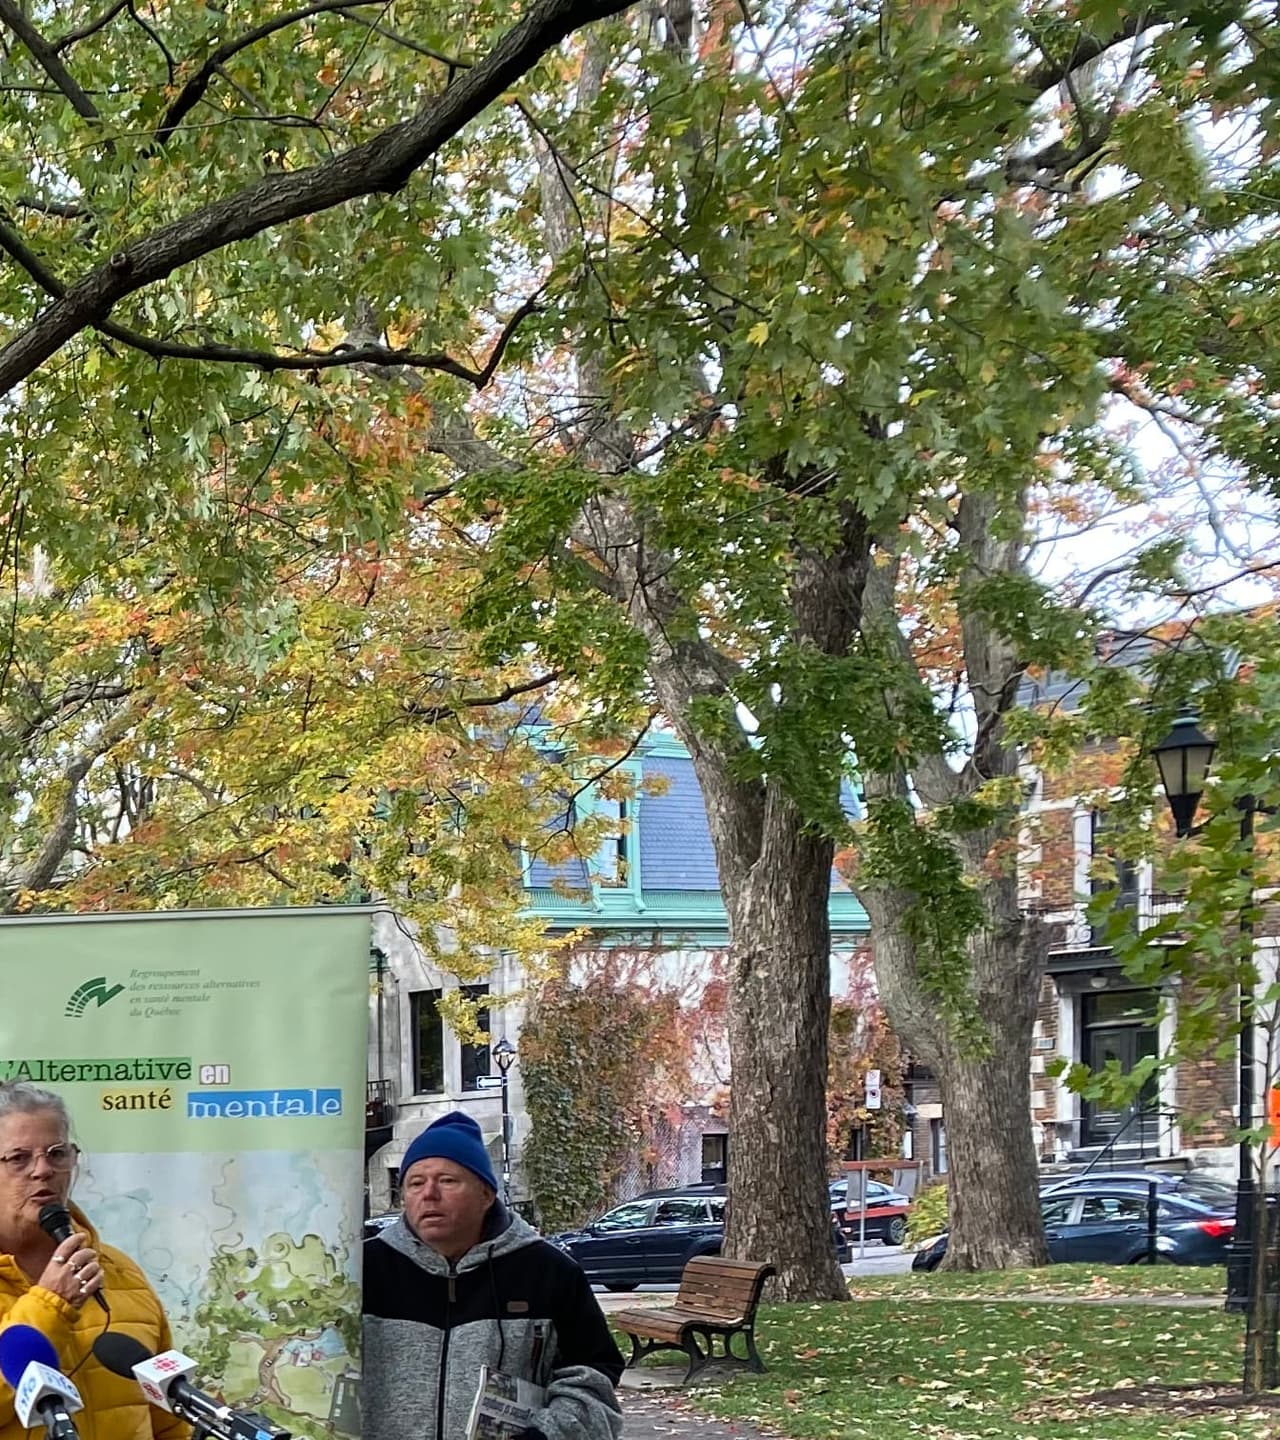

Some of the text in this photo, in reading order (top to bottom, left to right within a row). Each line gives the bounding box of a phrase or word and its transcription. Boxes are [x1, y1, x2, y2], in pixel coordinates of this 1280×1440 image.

[130, 969, 200, 979] Regroupement
[130, 980, 261, 991] des ressources alternatives
[144, 994, 170, 1003] santé
[172, 993, 211, 1002] mentale
[130, 1007, 183, 1018] du Québec
[201, 1065, 230, 1084] en
[102, 1087, 342, 1117] santé mentale
